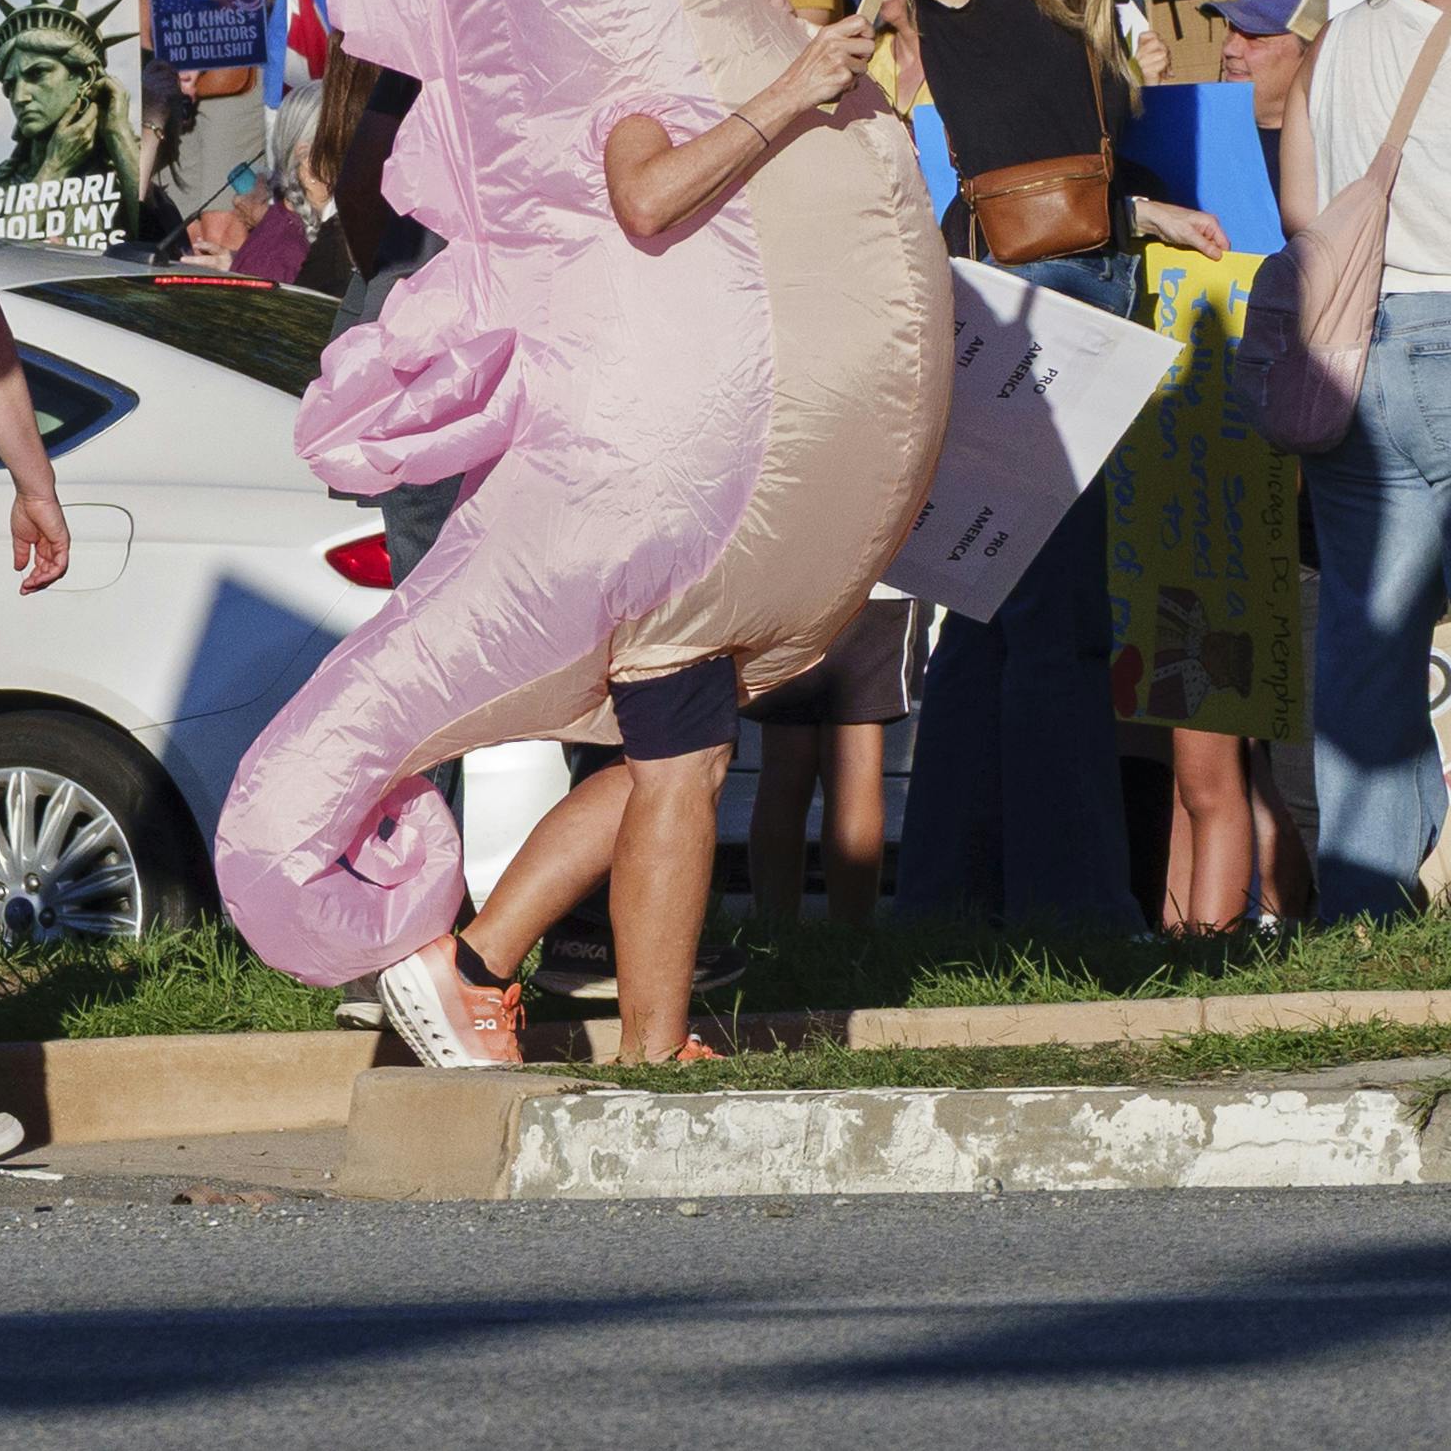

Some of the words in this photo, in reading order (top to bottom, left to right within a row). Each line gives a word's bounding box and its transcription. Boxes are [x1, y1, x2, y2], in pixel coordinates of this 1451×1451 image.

[171, 10, 194, 30] NO
[199, 7, 246, 28] KINGS
[164, 31, 182, 46] NO
[186, 25, 257, 45] DICTATORS
[170, 47, 187, 62] NO
[192, 41, 254, 60] BULLSHIT
[74, 201, 119, 234] MY
[66, 229, 126, 250] NGS
[957, 335, 985, 368] ANTI
[996, 341, 1043, 399] AMERICA
[1033, 367, 1059, 395] PRO
[947, 506, 994, 562] AMERICA
[983, 530, 1009, 557] PRO
[1261, 616, 1297, 740] Memphis
[550, 939, 608, 963] HOKA
